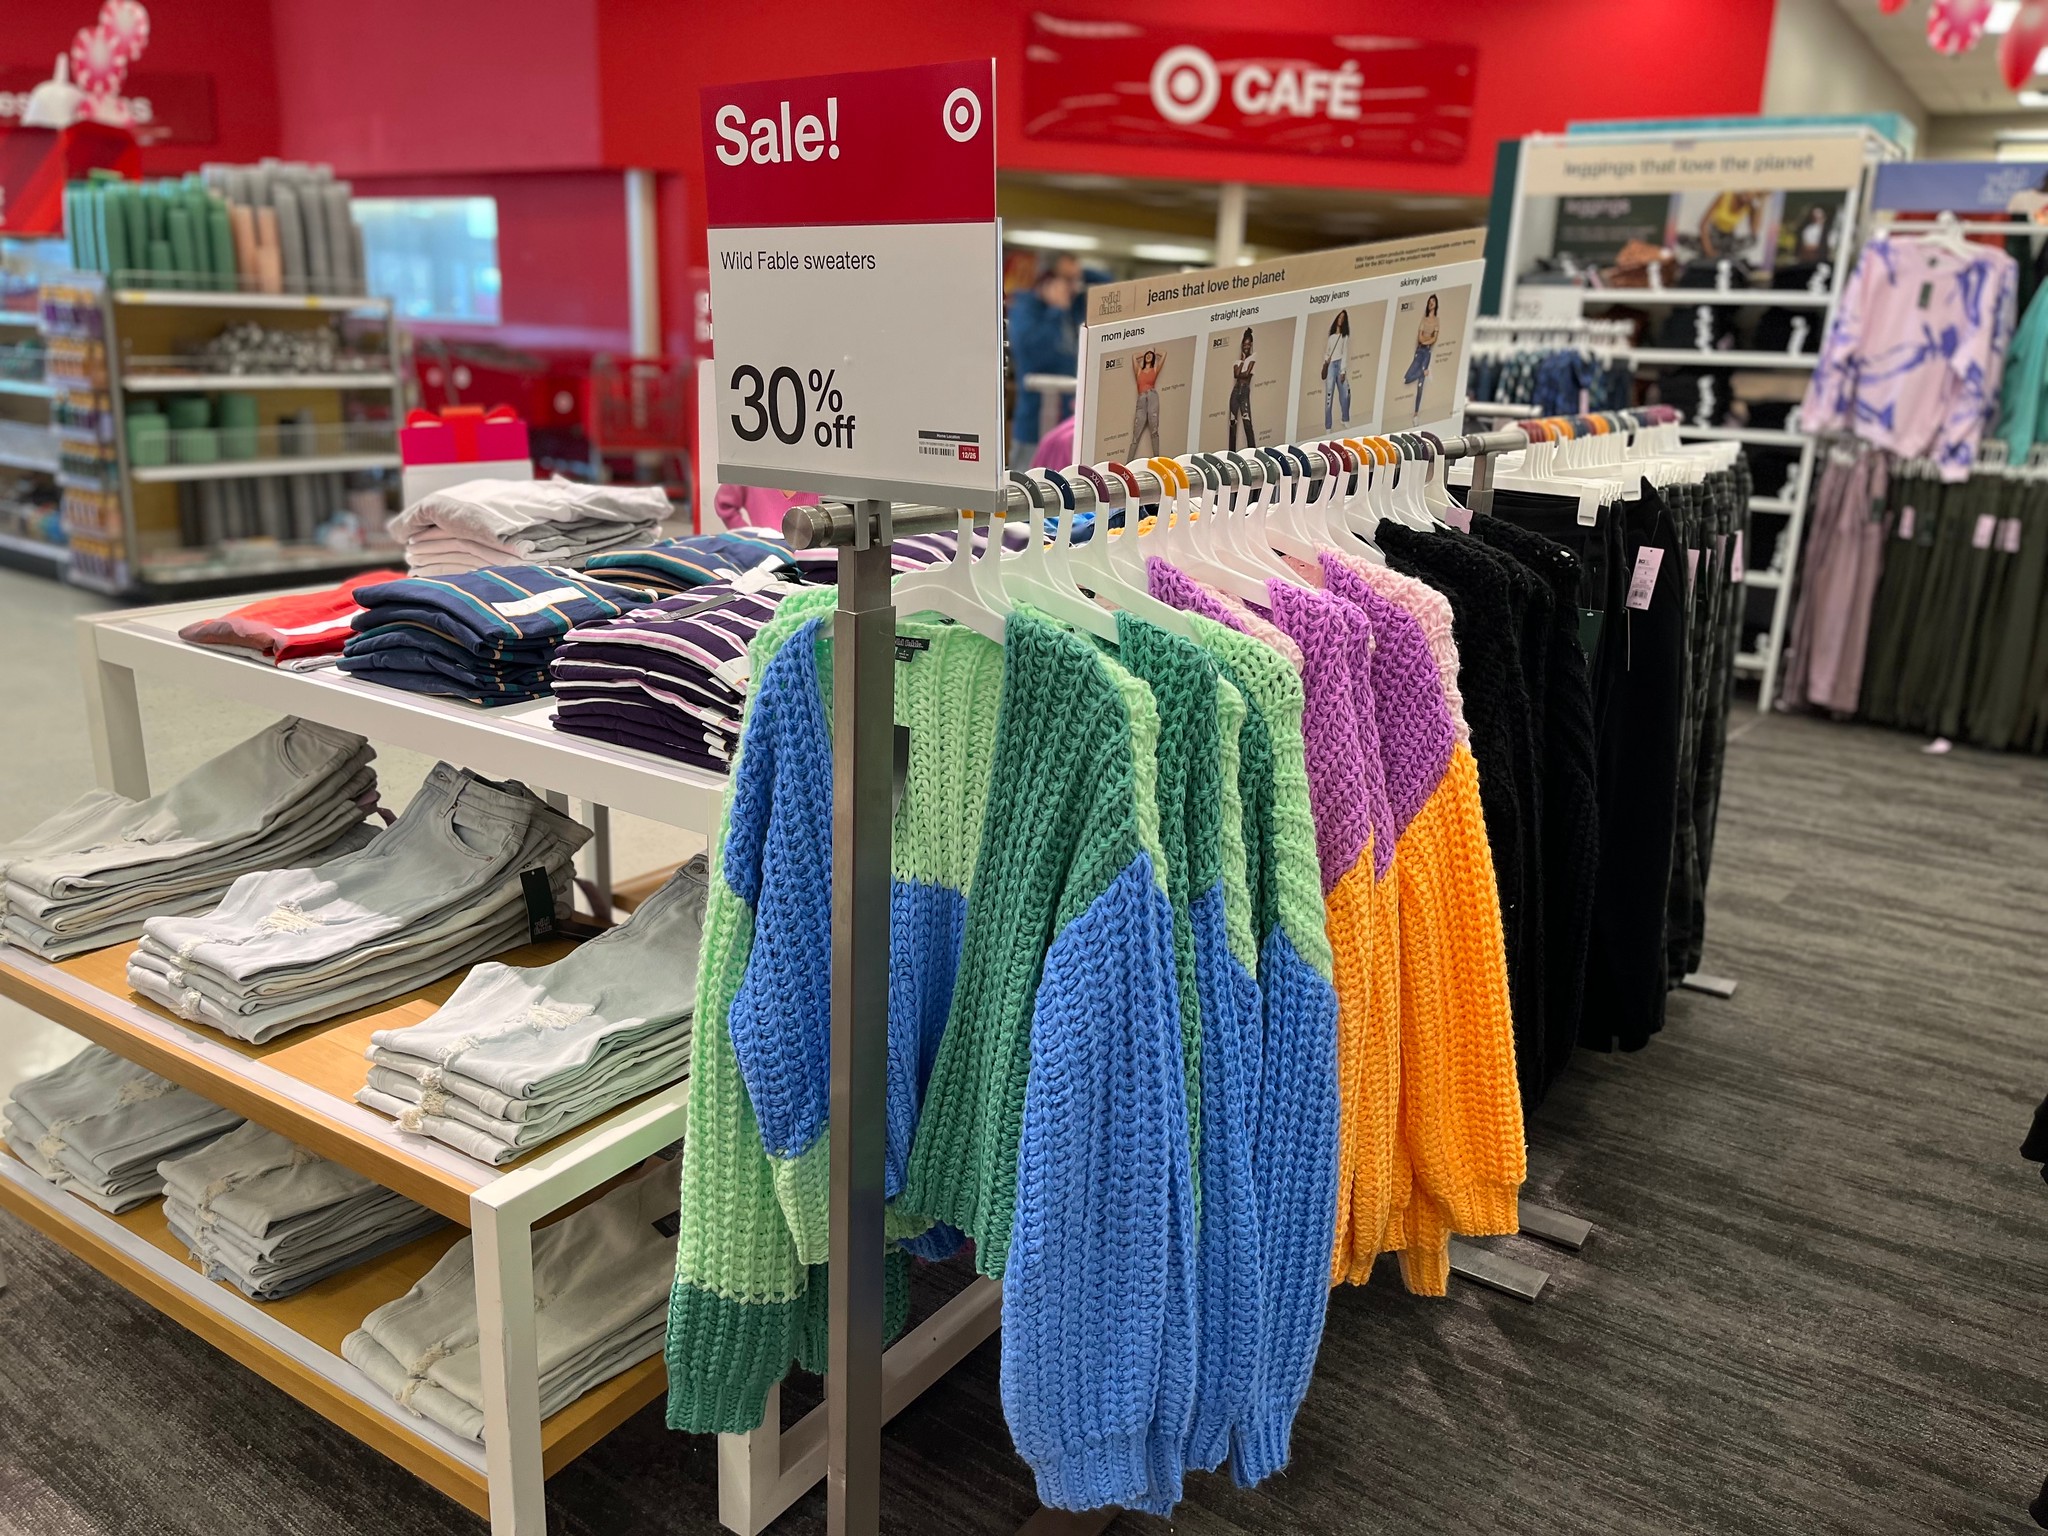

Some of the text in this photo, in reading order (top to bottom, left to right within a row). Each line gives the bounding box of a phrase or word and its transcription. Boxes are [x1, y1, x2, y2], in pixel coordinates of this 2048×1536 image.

[1231, 59, 1363, 120] CAFÉ
[715, 97, 840, 166] Sale!
[1639, 158, 1676, 173] that
[1679, 156, 1715, 173] love
[1720, 155, 1750, 171] the
[720, 251, 876, 270] Wild Fable sweaters
[1146, 268, 1286, 306] jeans that love the planet
[1400, 273, 1438, 288] skinny jeans
[1309, 289, 1350, 304] baggy jeans
[1210, 306, 1260, 323] straight jeans
[1101, 326, 1145, 343] mom jeans
[1212, 338, 1224, 348] BCI
[1105, 359, 1116, 369] BCI
[814, 415, 856, 449] off
[1090, 472, 1101, 487] XXL
[1121, 471, 1130, 481] XS
[1024, 480, 1032, 490] M
